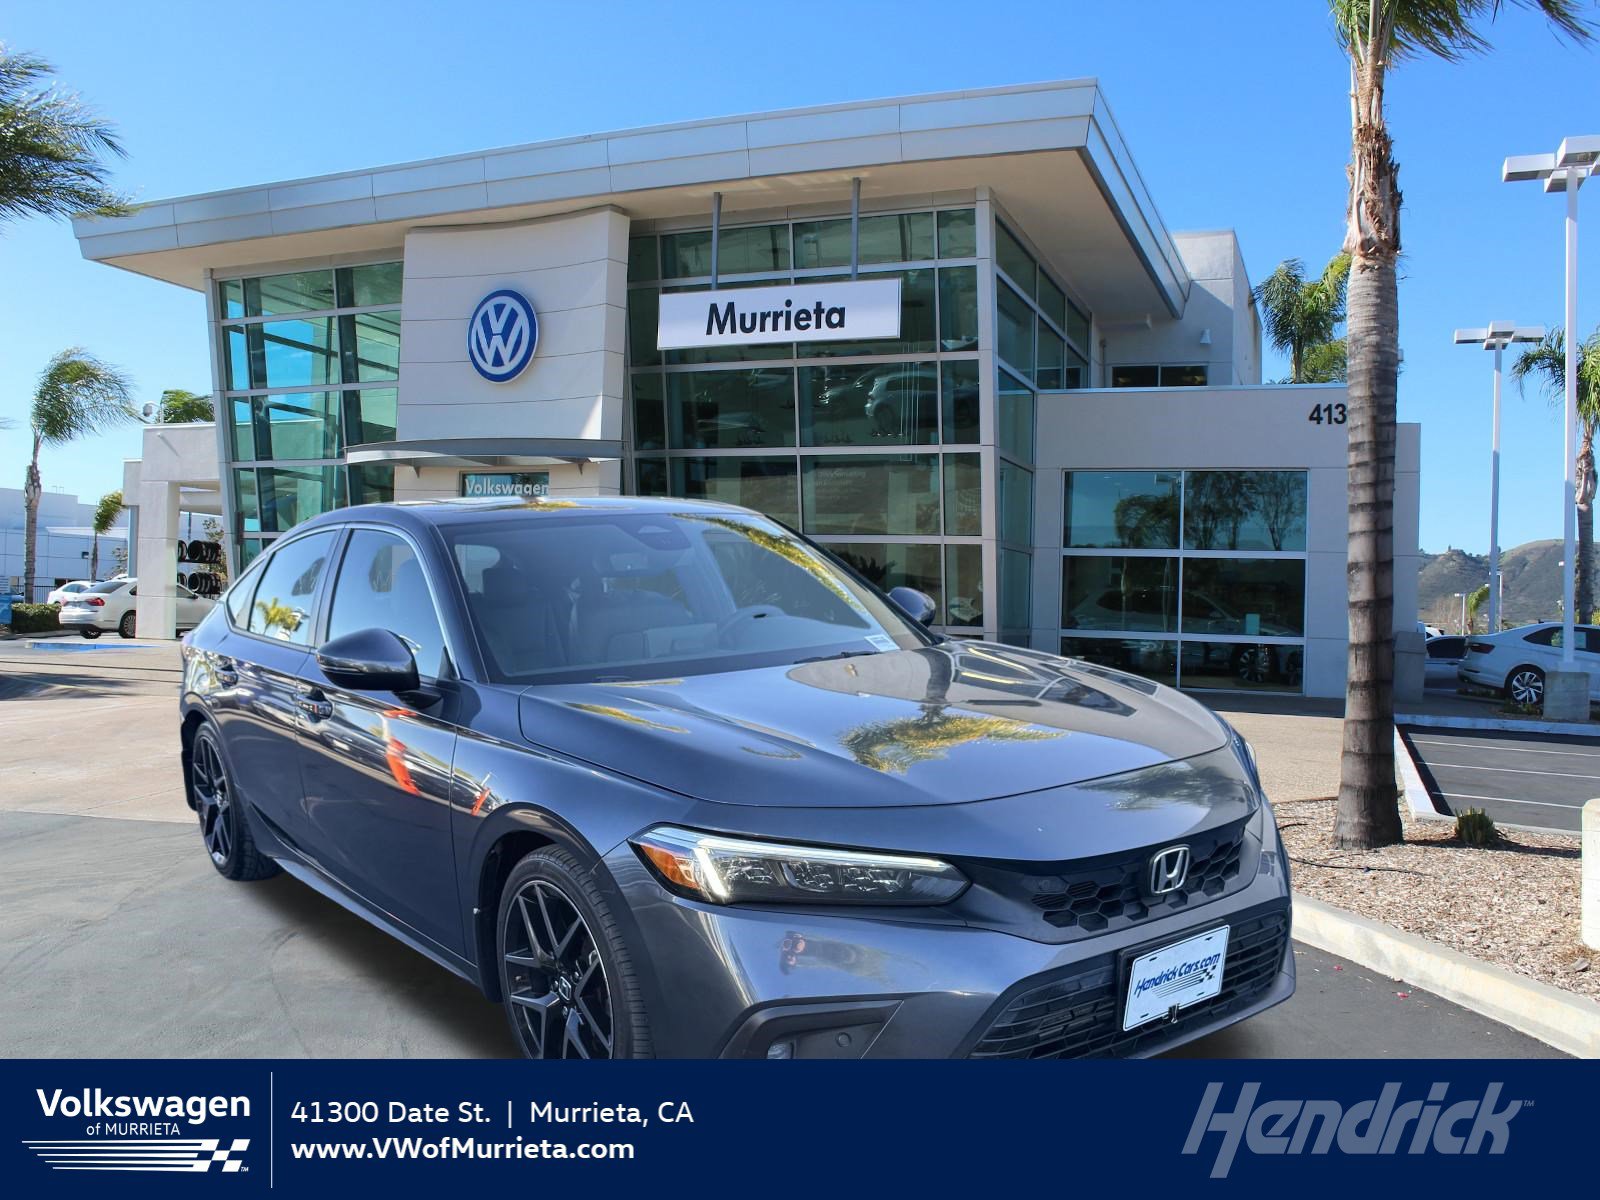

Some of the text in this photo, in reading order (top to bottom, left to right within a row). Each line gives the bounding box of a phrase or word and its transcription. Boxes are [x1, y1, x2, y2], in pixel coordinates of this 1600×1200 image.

[705, 299, 846, 336] Murrieta
[1308, 403, 1347, 425] 413
[464, 477, 549, 496] Volkswagen
